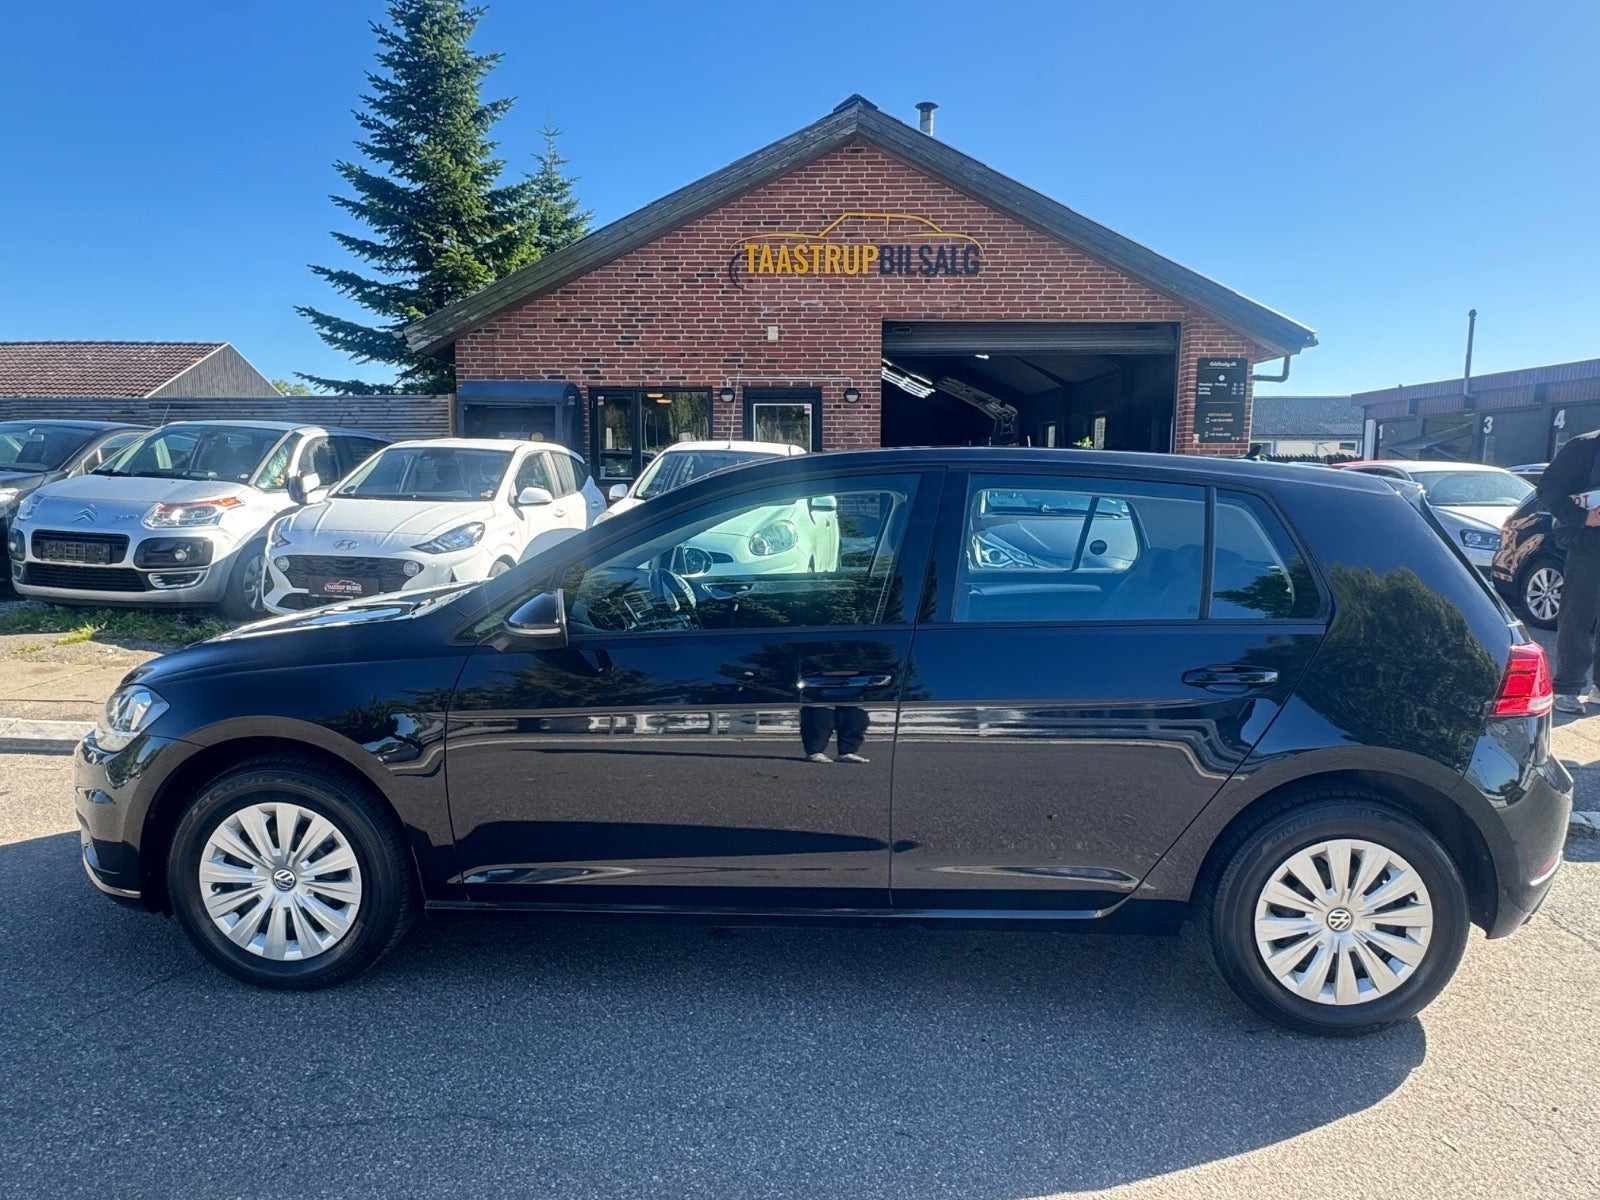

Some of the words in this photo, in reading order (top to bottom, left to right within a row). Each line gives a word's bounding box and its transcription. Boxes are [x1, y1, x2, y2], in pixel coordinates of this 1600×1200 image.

[1483, 415, 1493, 434] 3
[1553, 409, 1566, 429] 4
[1378, 424, 1384, 440] 1
